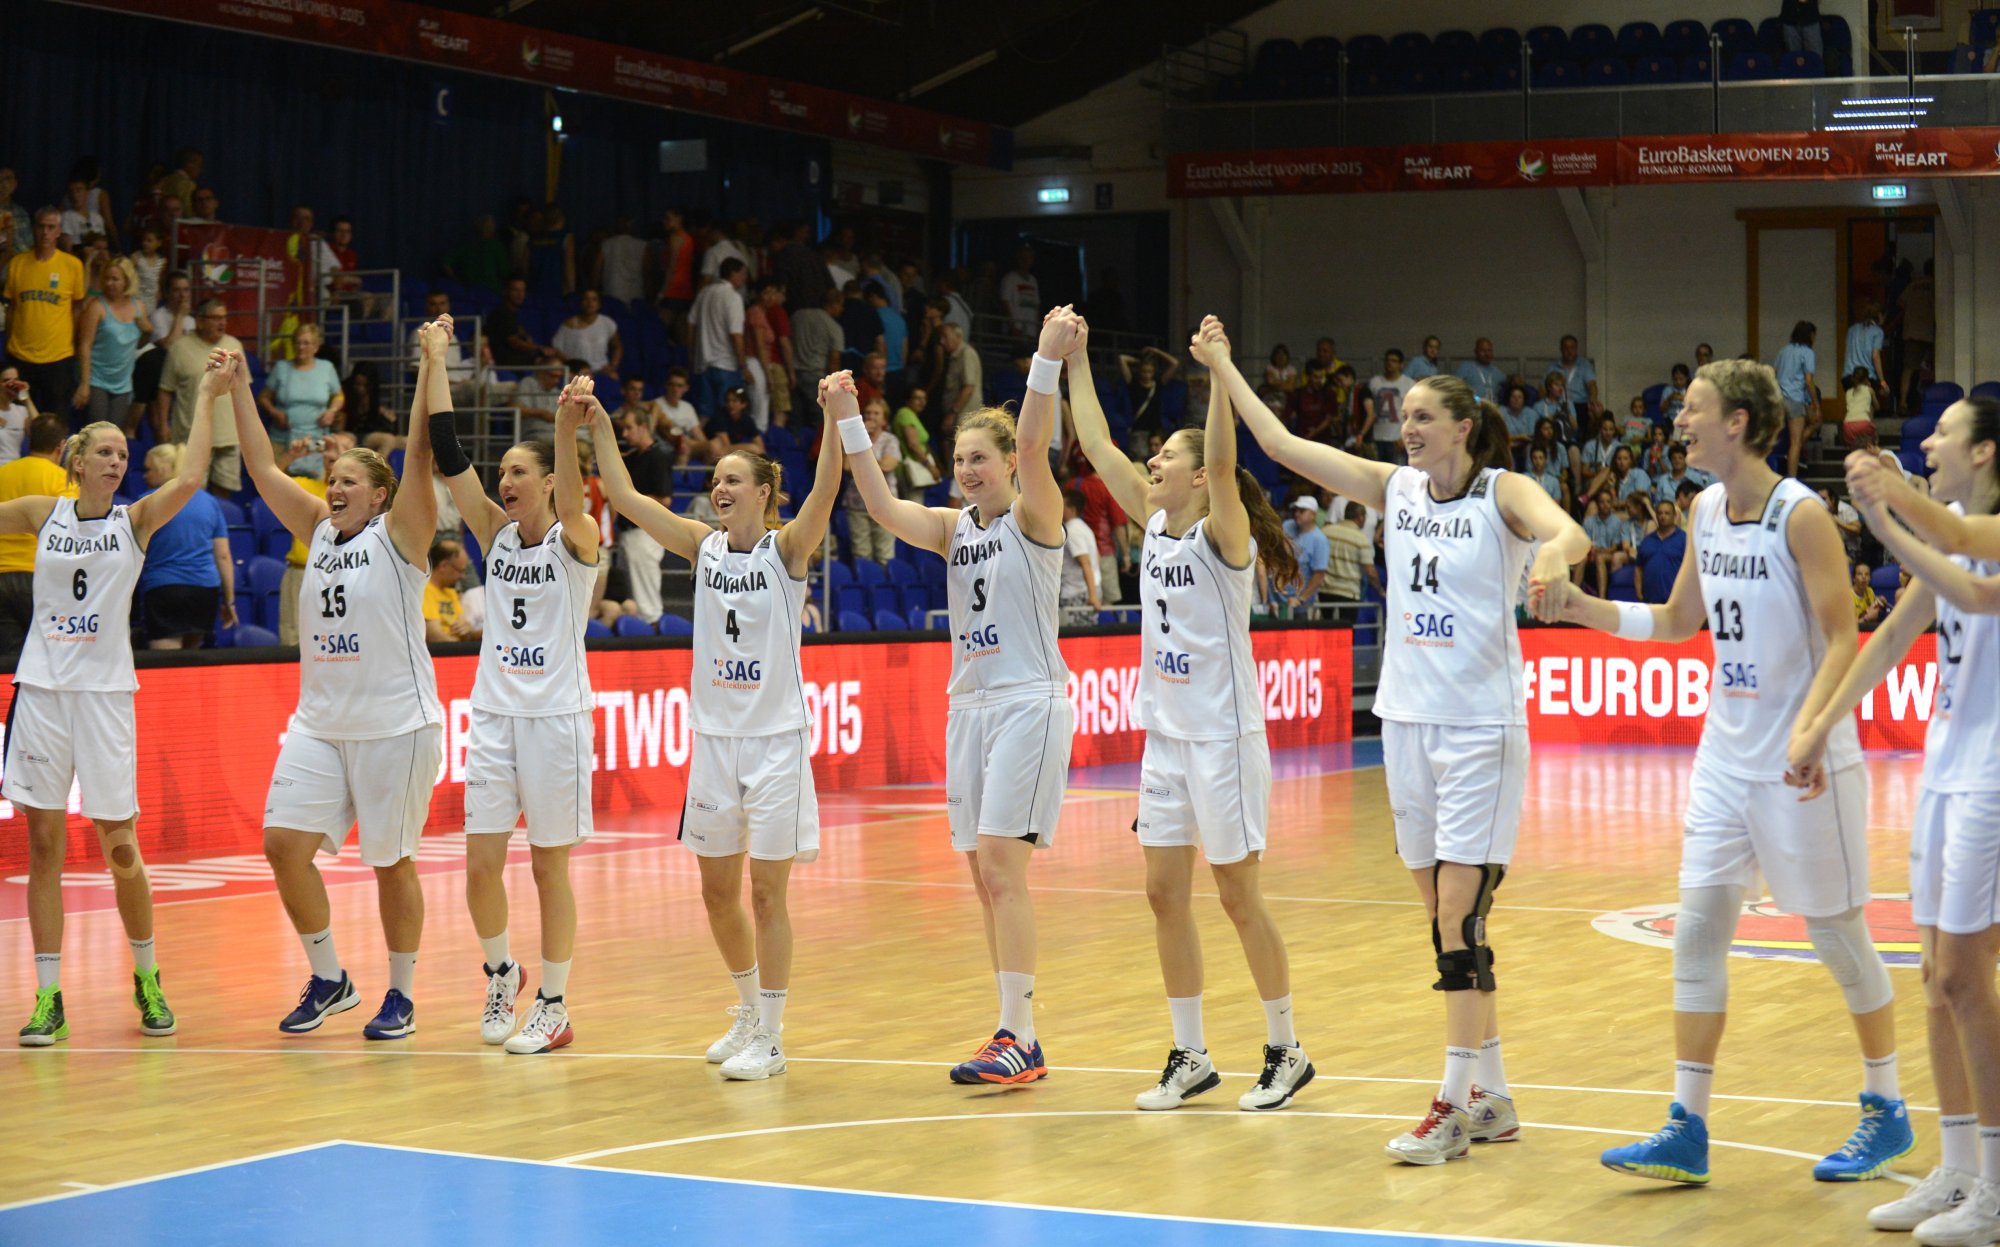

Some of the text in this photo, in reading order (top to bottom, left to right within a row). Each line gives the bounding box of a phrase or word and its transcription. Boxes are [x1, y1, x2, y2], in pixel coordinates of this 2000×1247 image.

[431, 34, 470, 52] HEART
[436, 89, 450, 117] C
[1795, 147, 1830, 162] 2015
[1875, 142, 1903, 153] PLAY
[1331, 161, 1363, 177] 2015
[1404, 156, 1431, 166] PLAY
[1875, 152, 1948, 167] WITH HEART
[1423, 165, 1473, 180] HEART
[46, 533, 120, 555] SLOVAKIA
[313, 548, 370, 574] SLOAKIA
[491, 558, 556, 585] SOAKIA
[1701, 549, 1770, 580] SOAKIA
[72, 568, 88, 601] 6
[1410, 552, 1439, 594] 14
[321, 584, 347, 619] 15
[66, 613, 100, 635] SAG
[511, 598, 527, 630] 5
[725, 608, 741, 643] 4
[1413, 613, 1455, 637] SAG
[1714, 598, 1744, 642] 13
[328, 633, 359, 654] SAG
[510, 646, 545, 667] SAG
[724, 660, 761, 681] SAG
[1722, 662, 1758, 689] SAG
